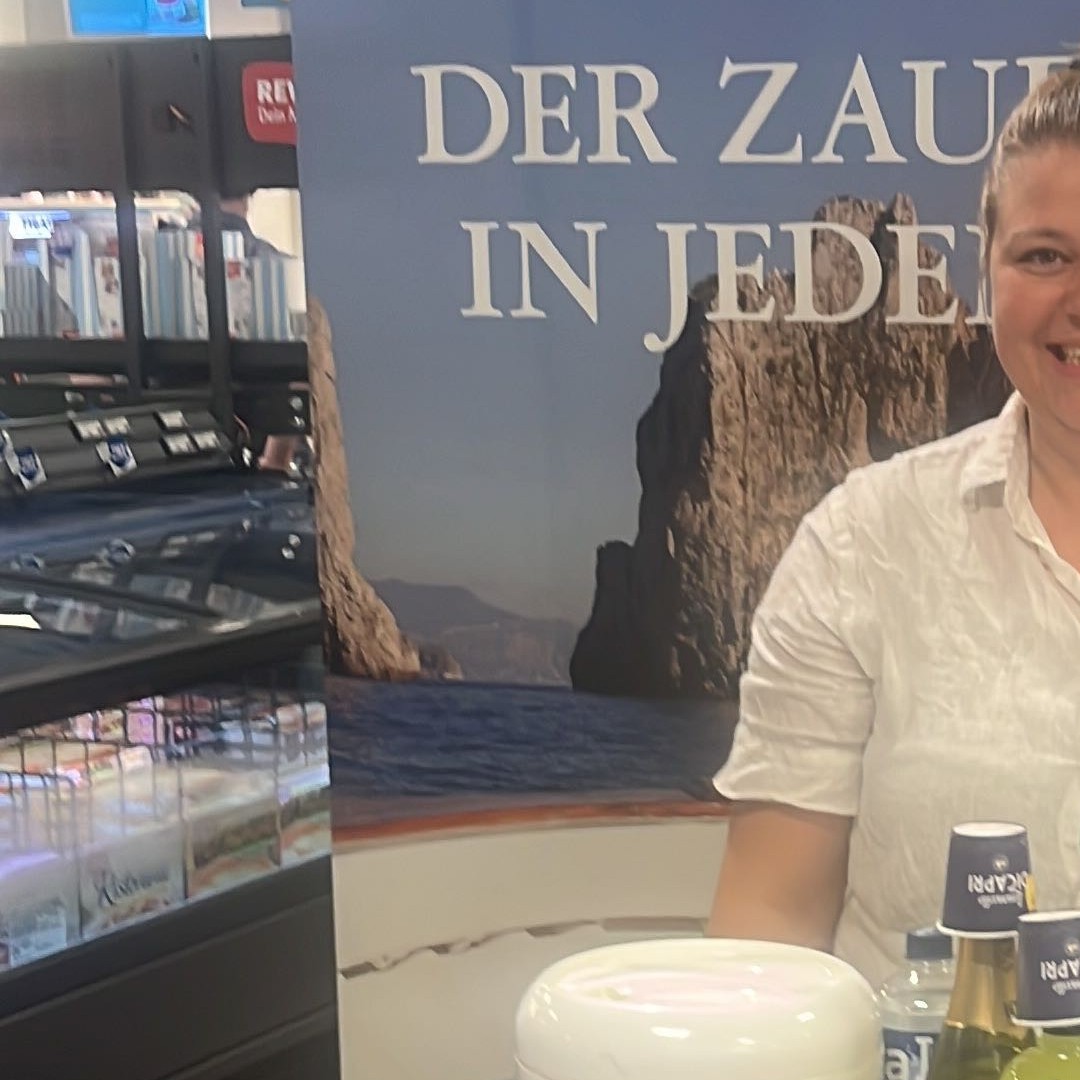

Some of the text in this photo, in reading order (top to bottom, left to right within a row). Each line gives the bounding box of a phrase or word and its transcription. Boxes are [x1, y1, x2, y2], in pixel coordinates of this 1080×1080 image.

[257, 78, 295, 104] RE
[410, 63, 677, 165] DER
[460, 220, 607, 325] IN
[643, 221, 993, 354] JEDE
